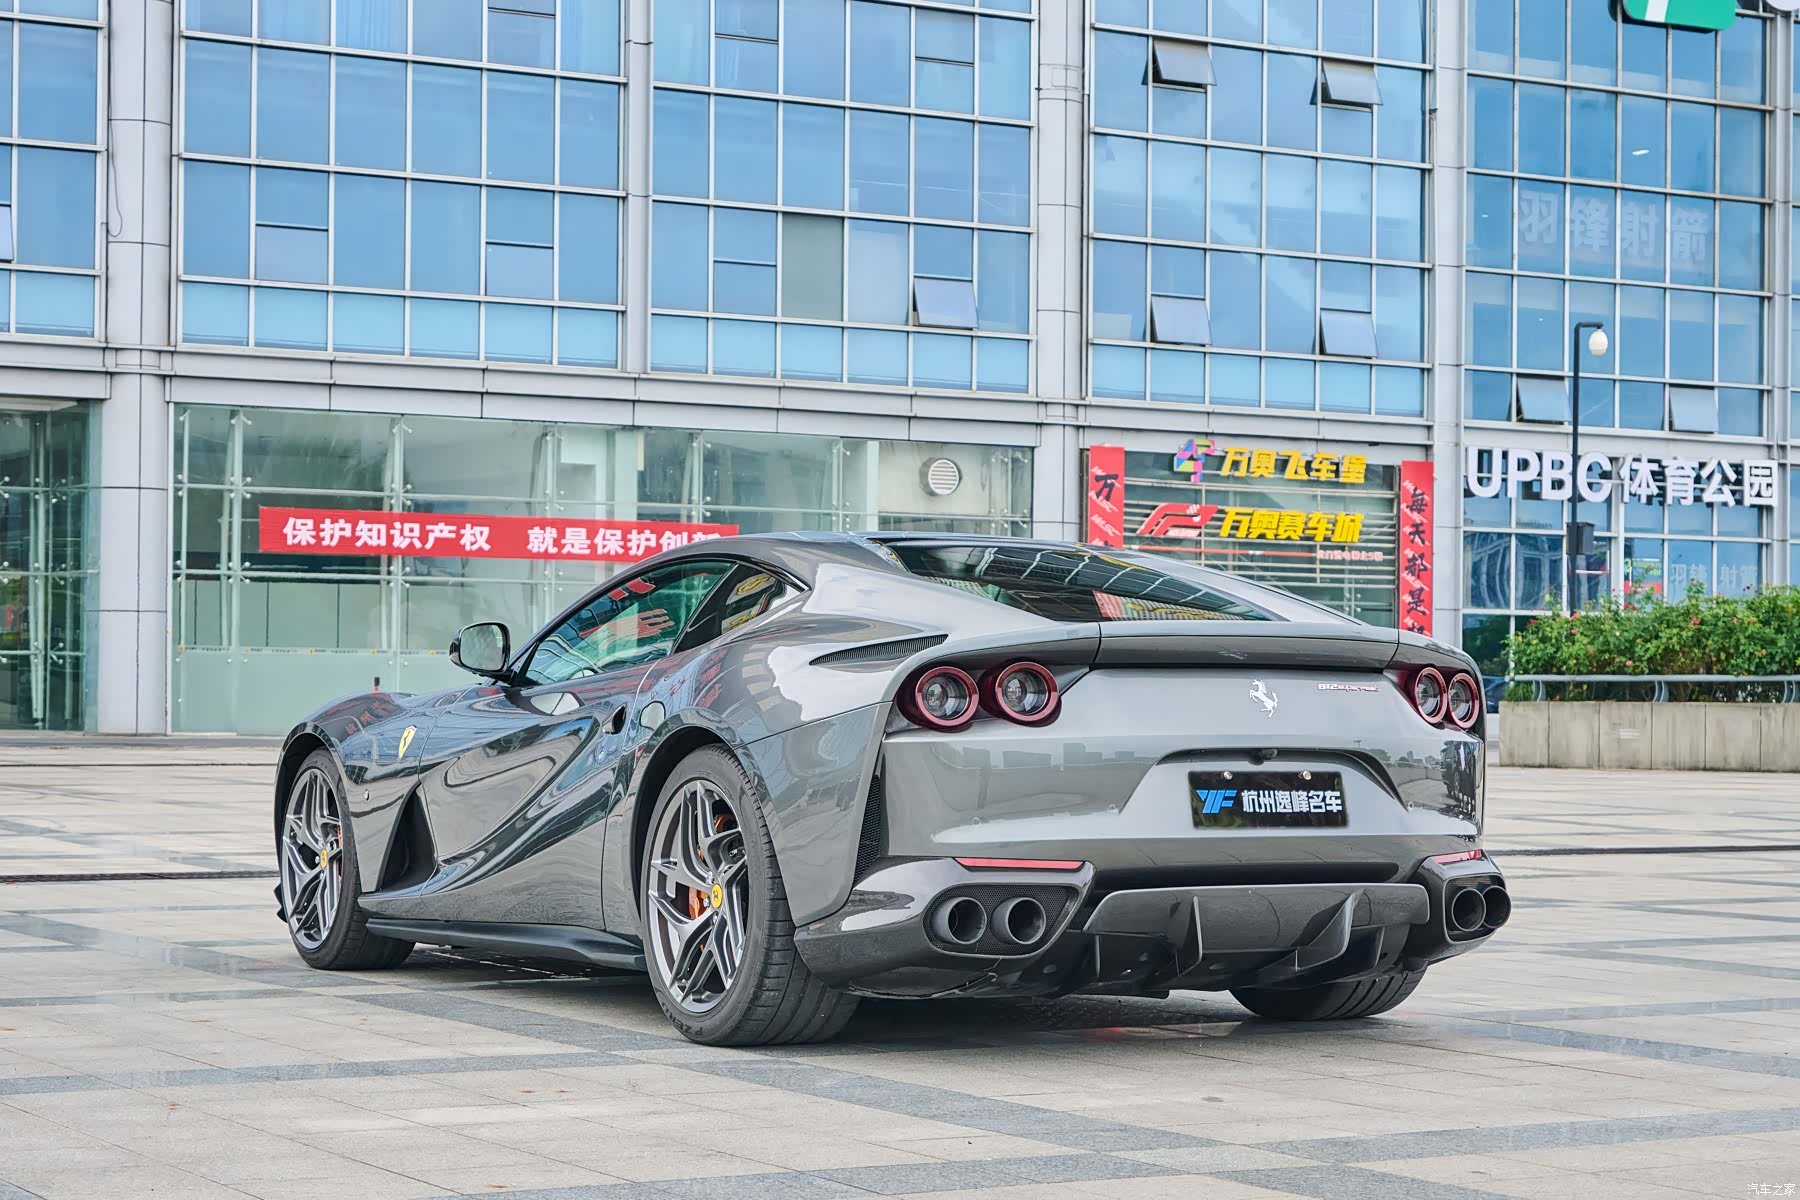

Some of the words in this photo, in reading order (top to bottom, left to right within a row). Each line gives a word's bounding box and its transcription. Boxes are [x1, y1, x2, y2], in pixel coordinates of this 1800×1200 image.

[1221, 447, 1366, 483] 万奥飞车堡
[283, 517, 491, 551] 保护知识产权
[1219, 507, 1364, 542] 万奥赛车城
[1241, 790, 1342, 813] 杭州逸峰名车
